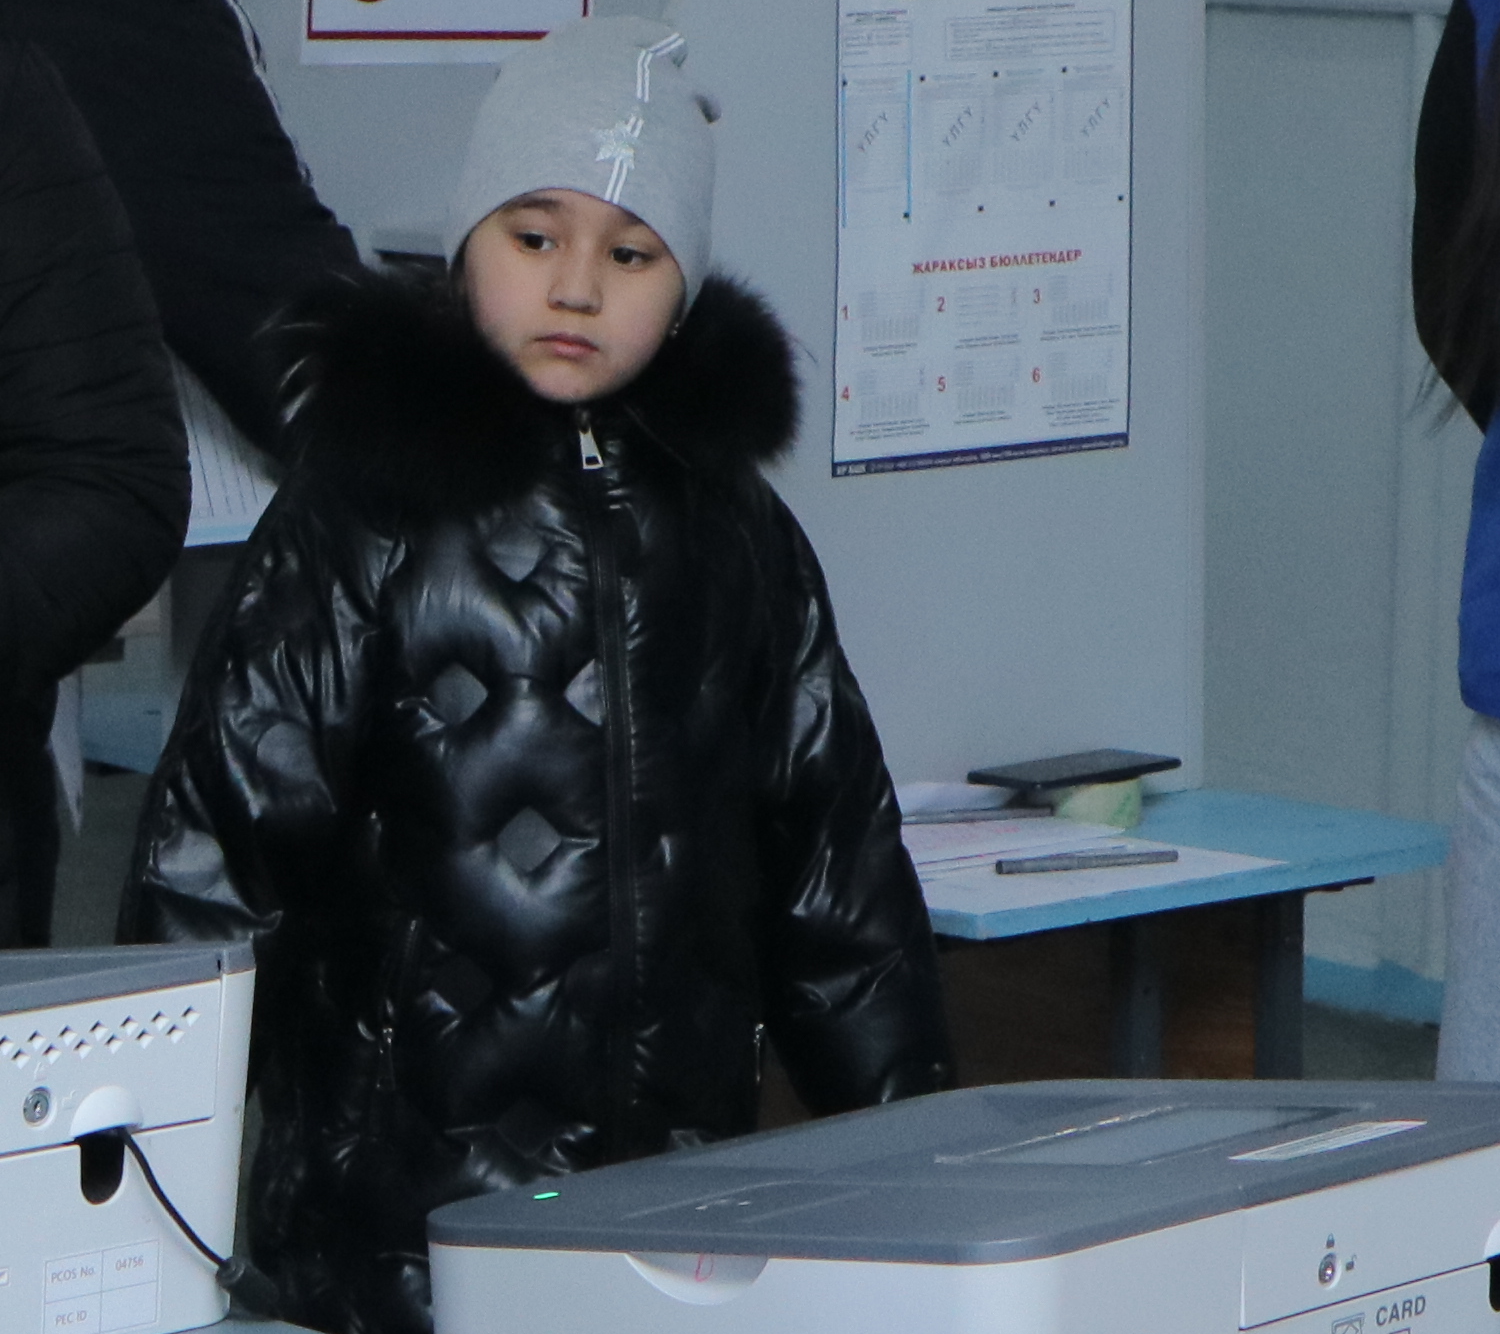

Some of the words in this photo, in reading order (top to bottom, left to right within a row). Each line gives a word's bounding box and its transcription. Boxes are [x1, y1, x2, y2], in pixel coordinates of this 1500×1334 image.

[912, 257, 986, 274] ЖАРАКСЫЗ
[990, 249, 1083, 268] БЮЛЛЕТЕНДЕР
[937, 296, 946, 313] 2
[1033, 289, 1042, 304] 3
[841, 305, 849, 320] 1
[1032, 367, 1041, 383] 6
[937, 376, 946, 392] 5
[841, 385, 850, 401] 4
[51, 1268, 78, 1283] PCOS
[55, 1312, 75, 1327] PEC
[76, 1309, 88, 1322] ID
[1374, 1296, 1427, 1327] CARD
